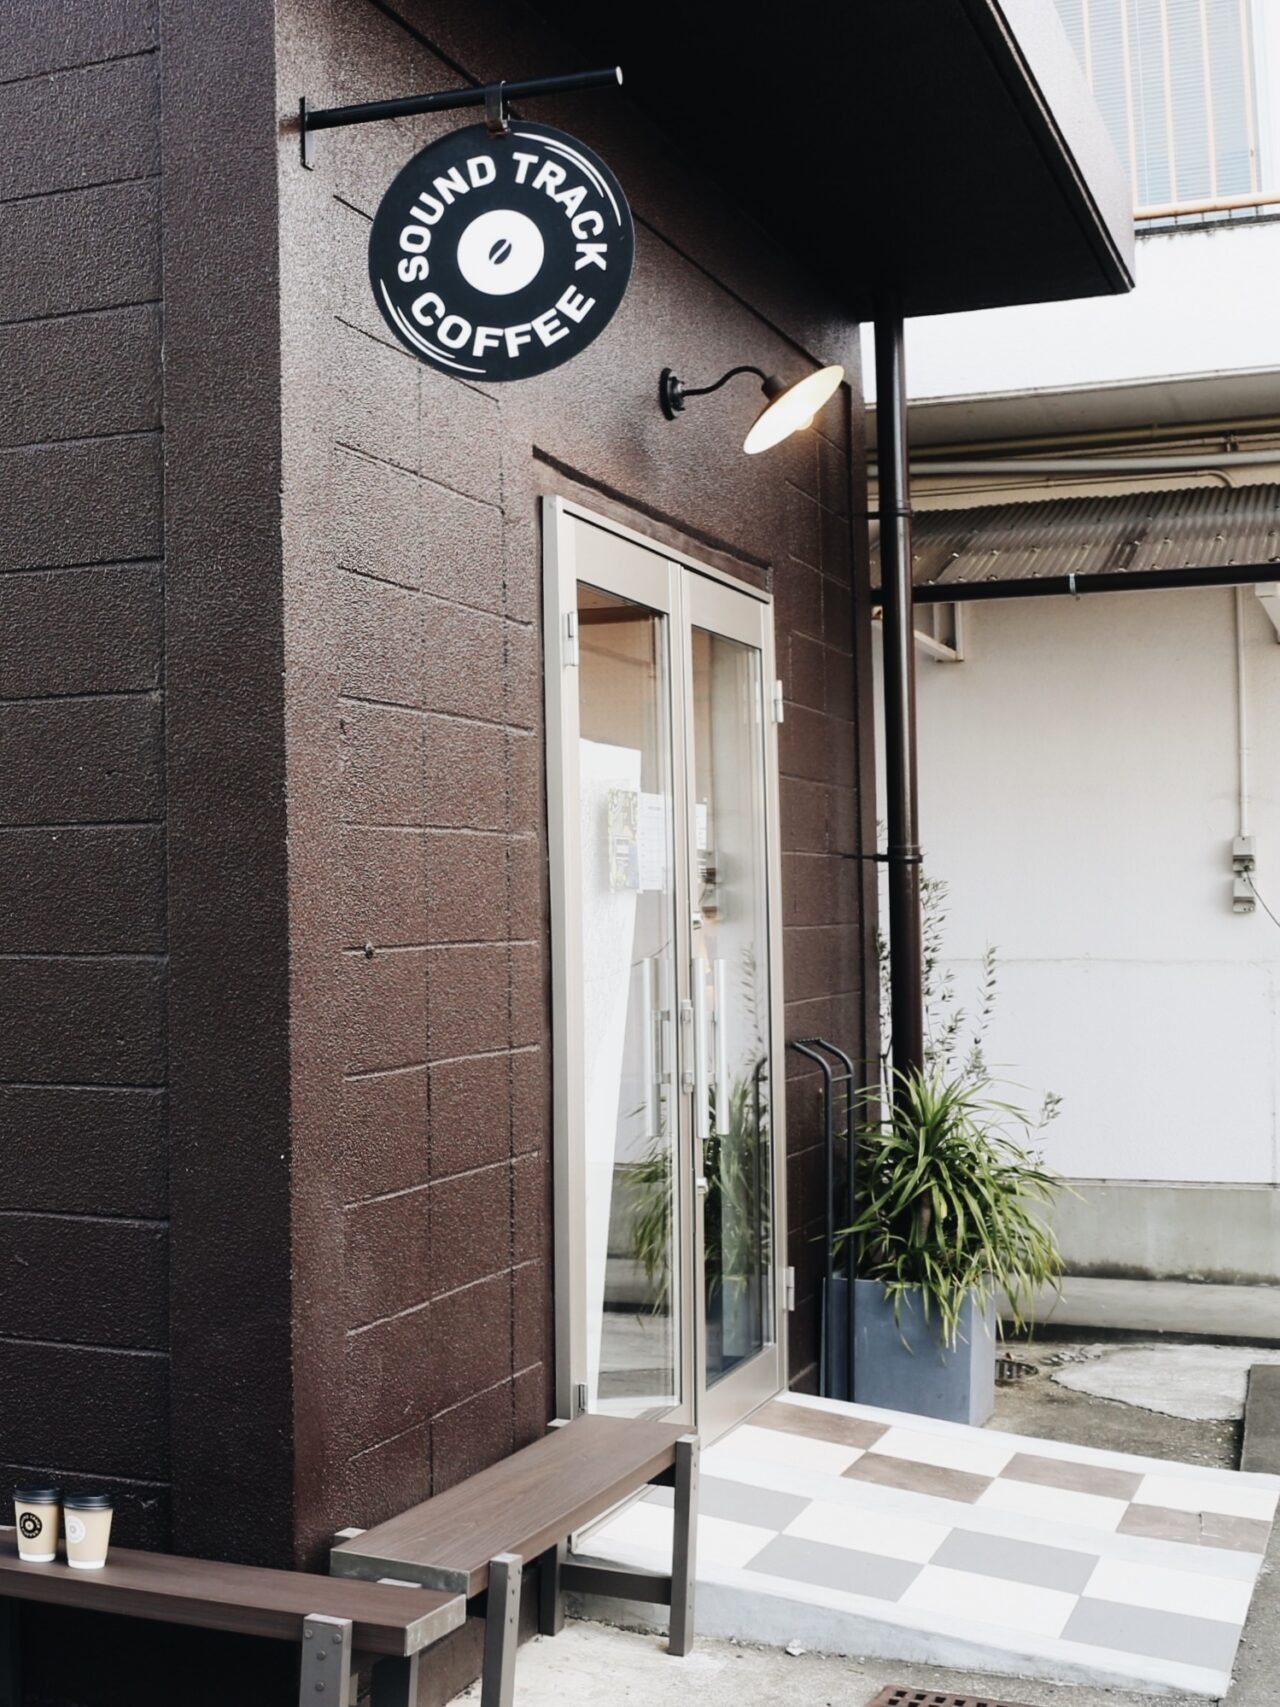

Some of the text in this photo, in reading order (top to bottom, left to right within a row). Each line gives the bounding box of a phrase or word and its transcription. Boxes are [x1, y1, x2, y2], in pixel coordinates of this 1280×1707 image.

[398, 152, 608, 283] SOUND TRACK
[411, 284, 596, 358] COFFEE
